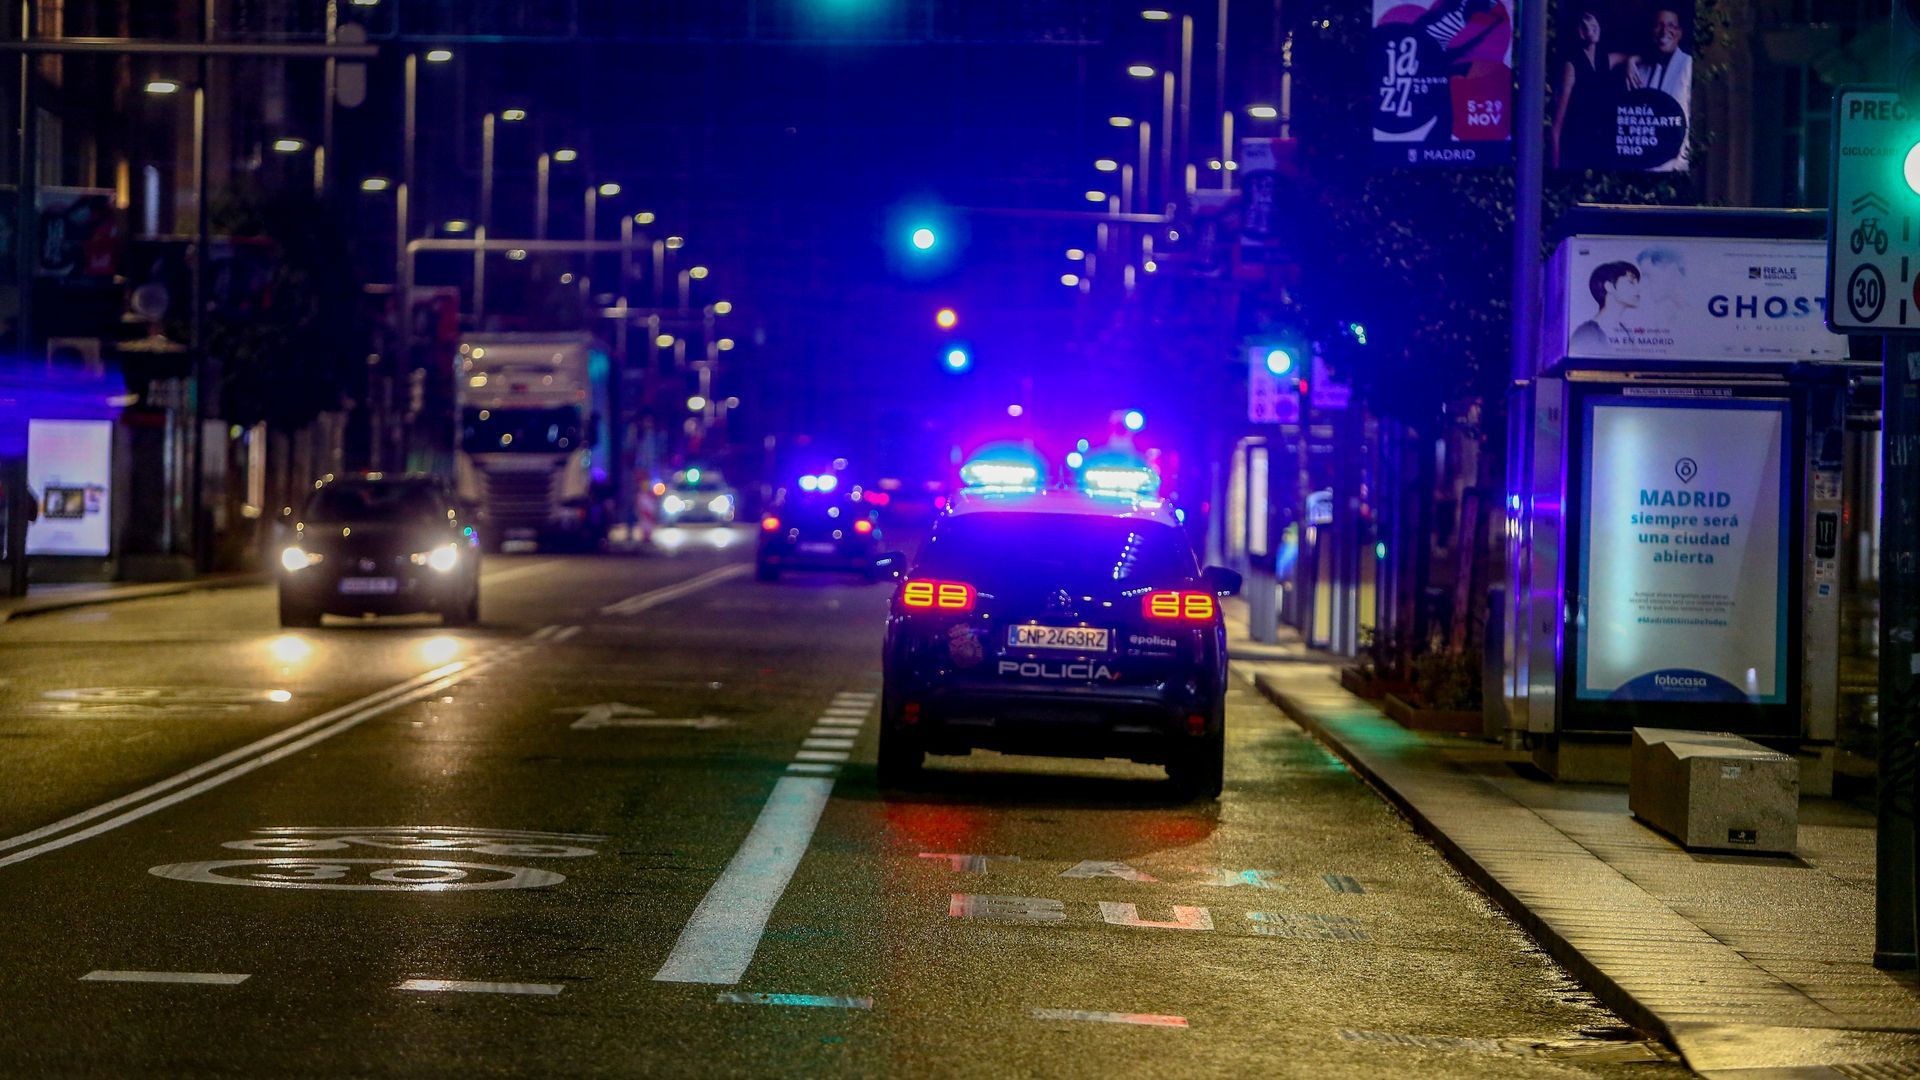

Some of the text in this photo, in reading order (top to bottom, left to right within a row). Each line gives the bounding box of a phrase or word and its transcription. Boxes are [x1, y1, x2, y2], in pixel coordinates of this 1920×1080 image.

[1468, 99, 1502, 113] 5-29
[1617, 104, 1654, 116] MARÍA
[1468, 113, 1501, 126] NOV
[1617, 116, 1682, 126] BERASARTE
[1629, 126, 1655, 136] PEPE
[1616, 136, 1658, 146] RIVERO
[1424, 149, 1476, 160] MADRID
[1616, 145, 1643, 155] TRIO
[1763, 266, 1797, 274] REALE
[1855, 278, 1878, 309] 30
[1638, 337, 1674, 345] MADRID
[1640, 489, 1731, 508] MADRID
[1631, 512, 1738, 529] siempre será
[1638, 531, 1730, 546] una ciudad
[1653, 551, 1714, 564] abierta
[1129, 634, 1177, 647] @policia
[999, 659, 1112, 680] POLICÍA
[1655, 674, 1707, 687] fotocasa
